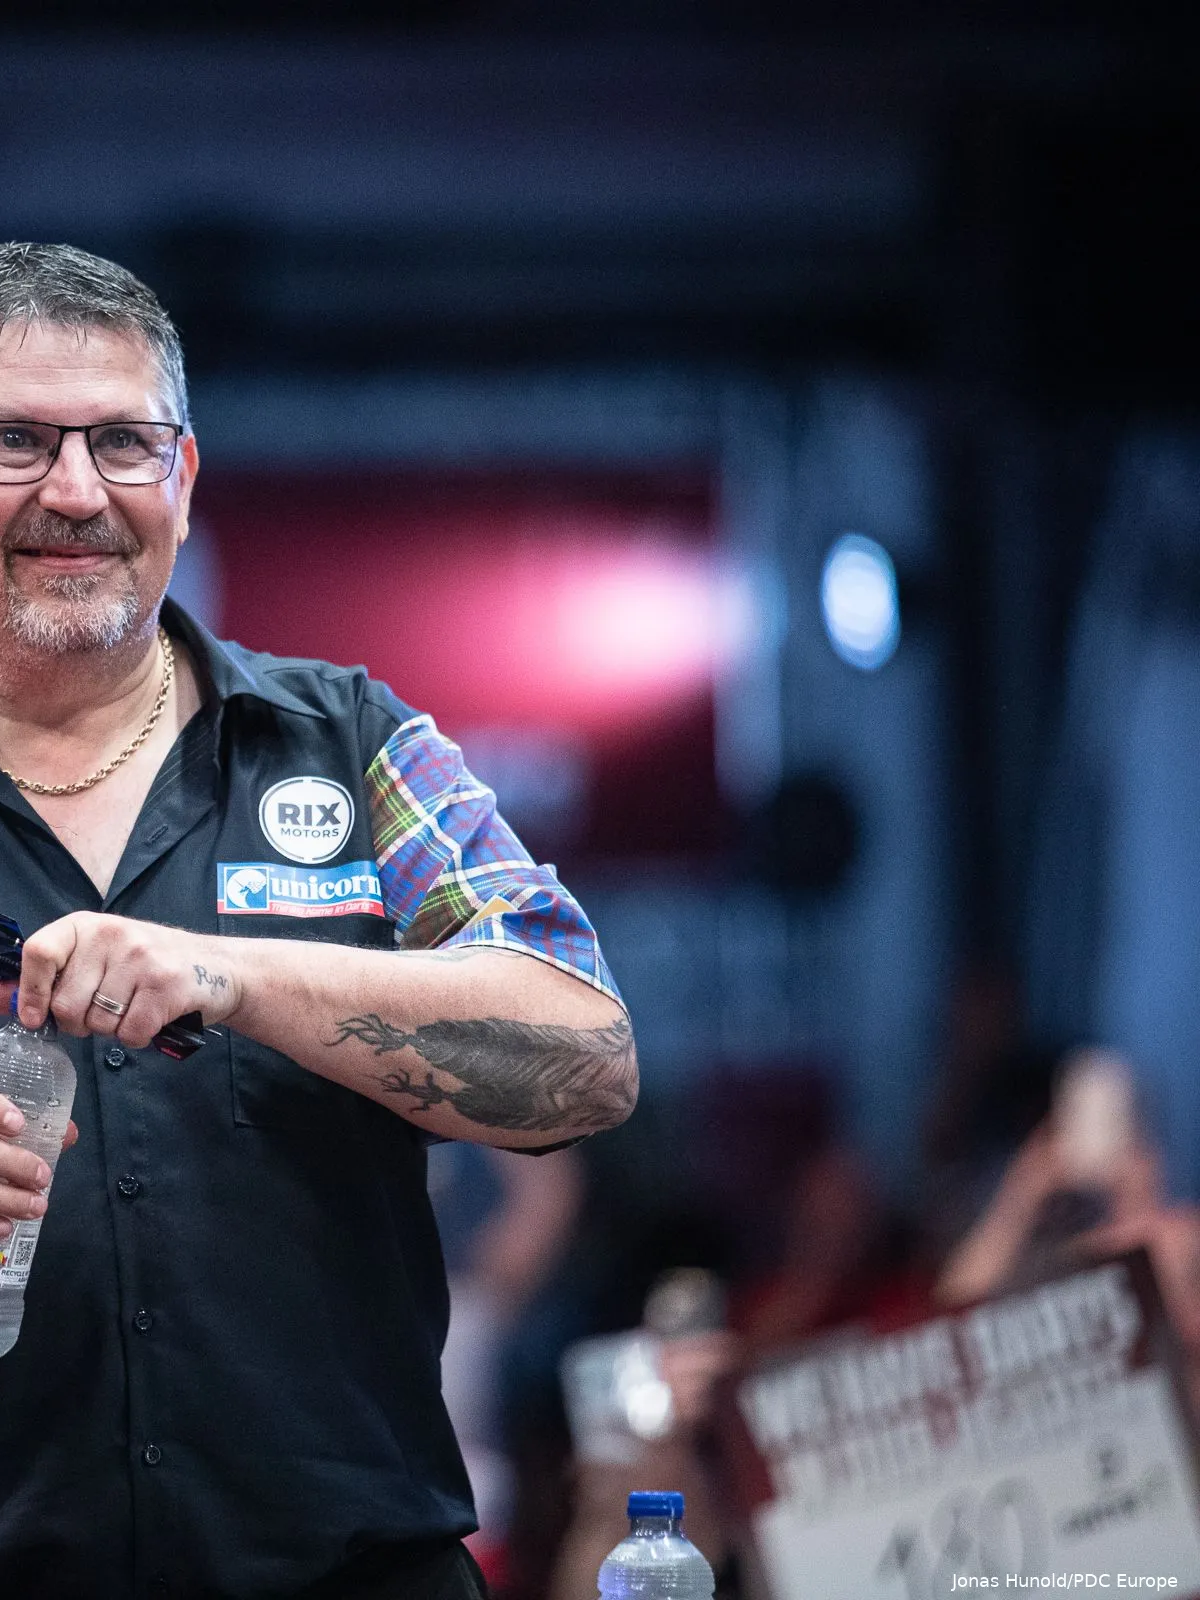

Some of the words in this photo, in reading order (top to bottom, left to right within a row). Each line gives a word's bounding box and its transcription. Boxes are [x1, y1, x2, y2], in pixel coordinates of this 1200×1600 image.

[277, 801, 341, 827] RIX
[280, 827, 340, 839] MOTORS
[271, 874, 382, 900] unicorn
